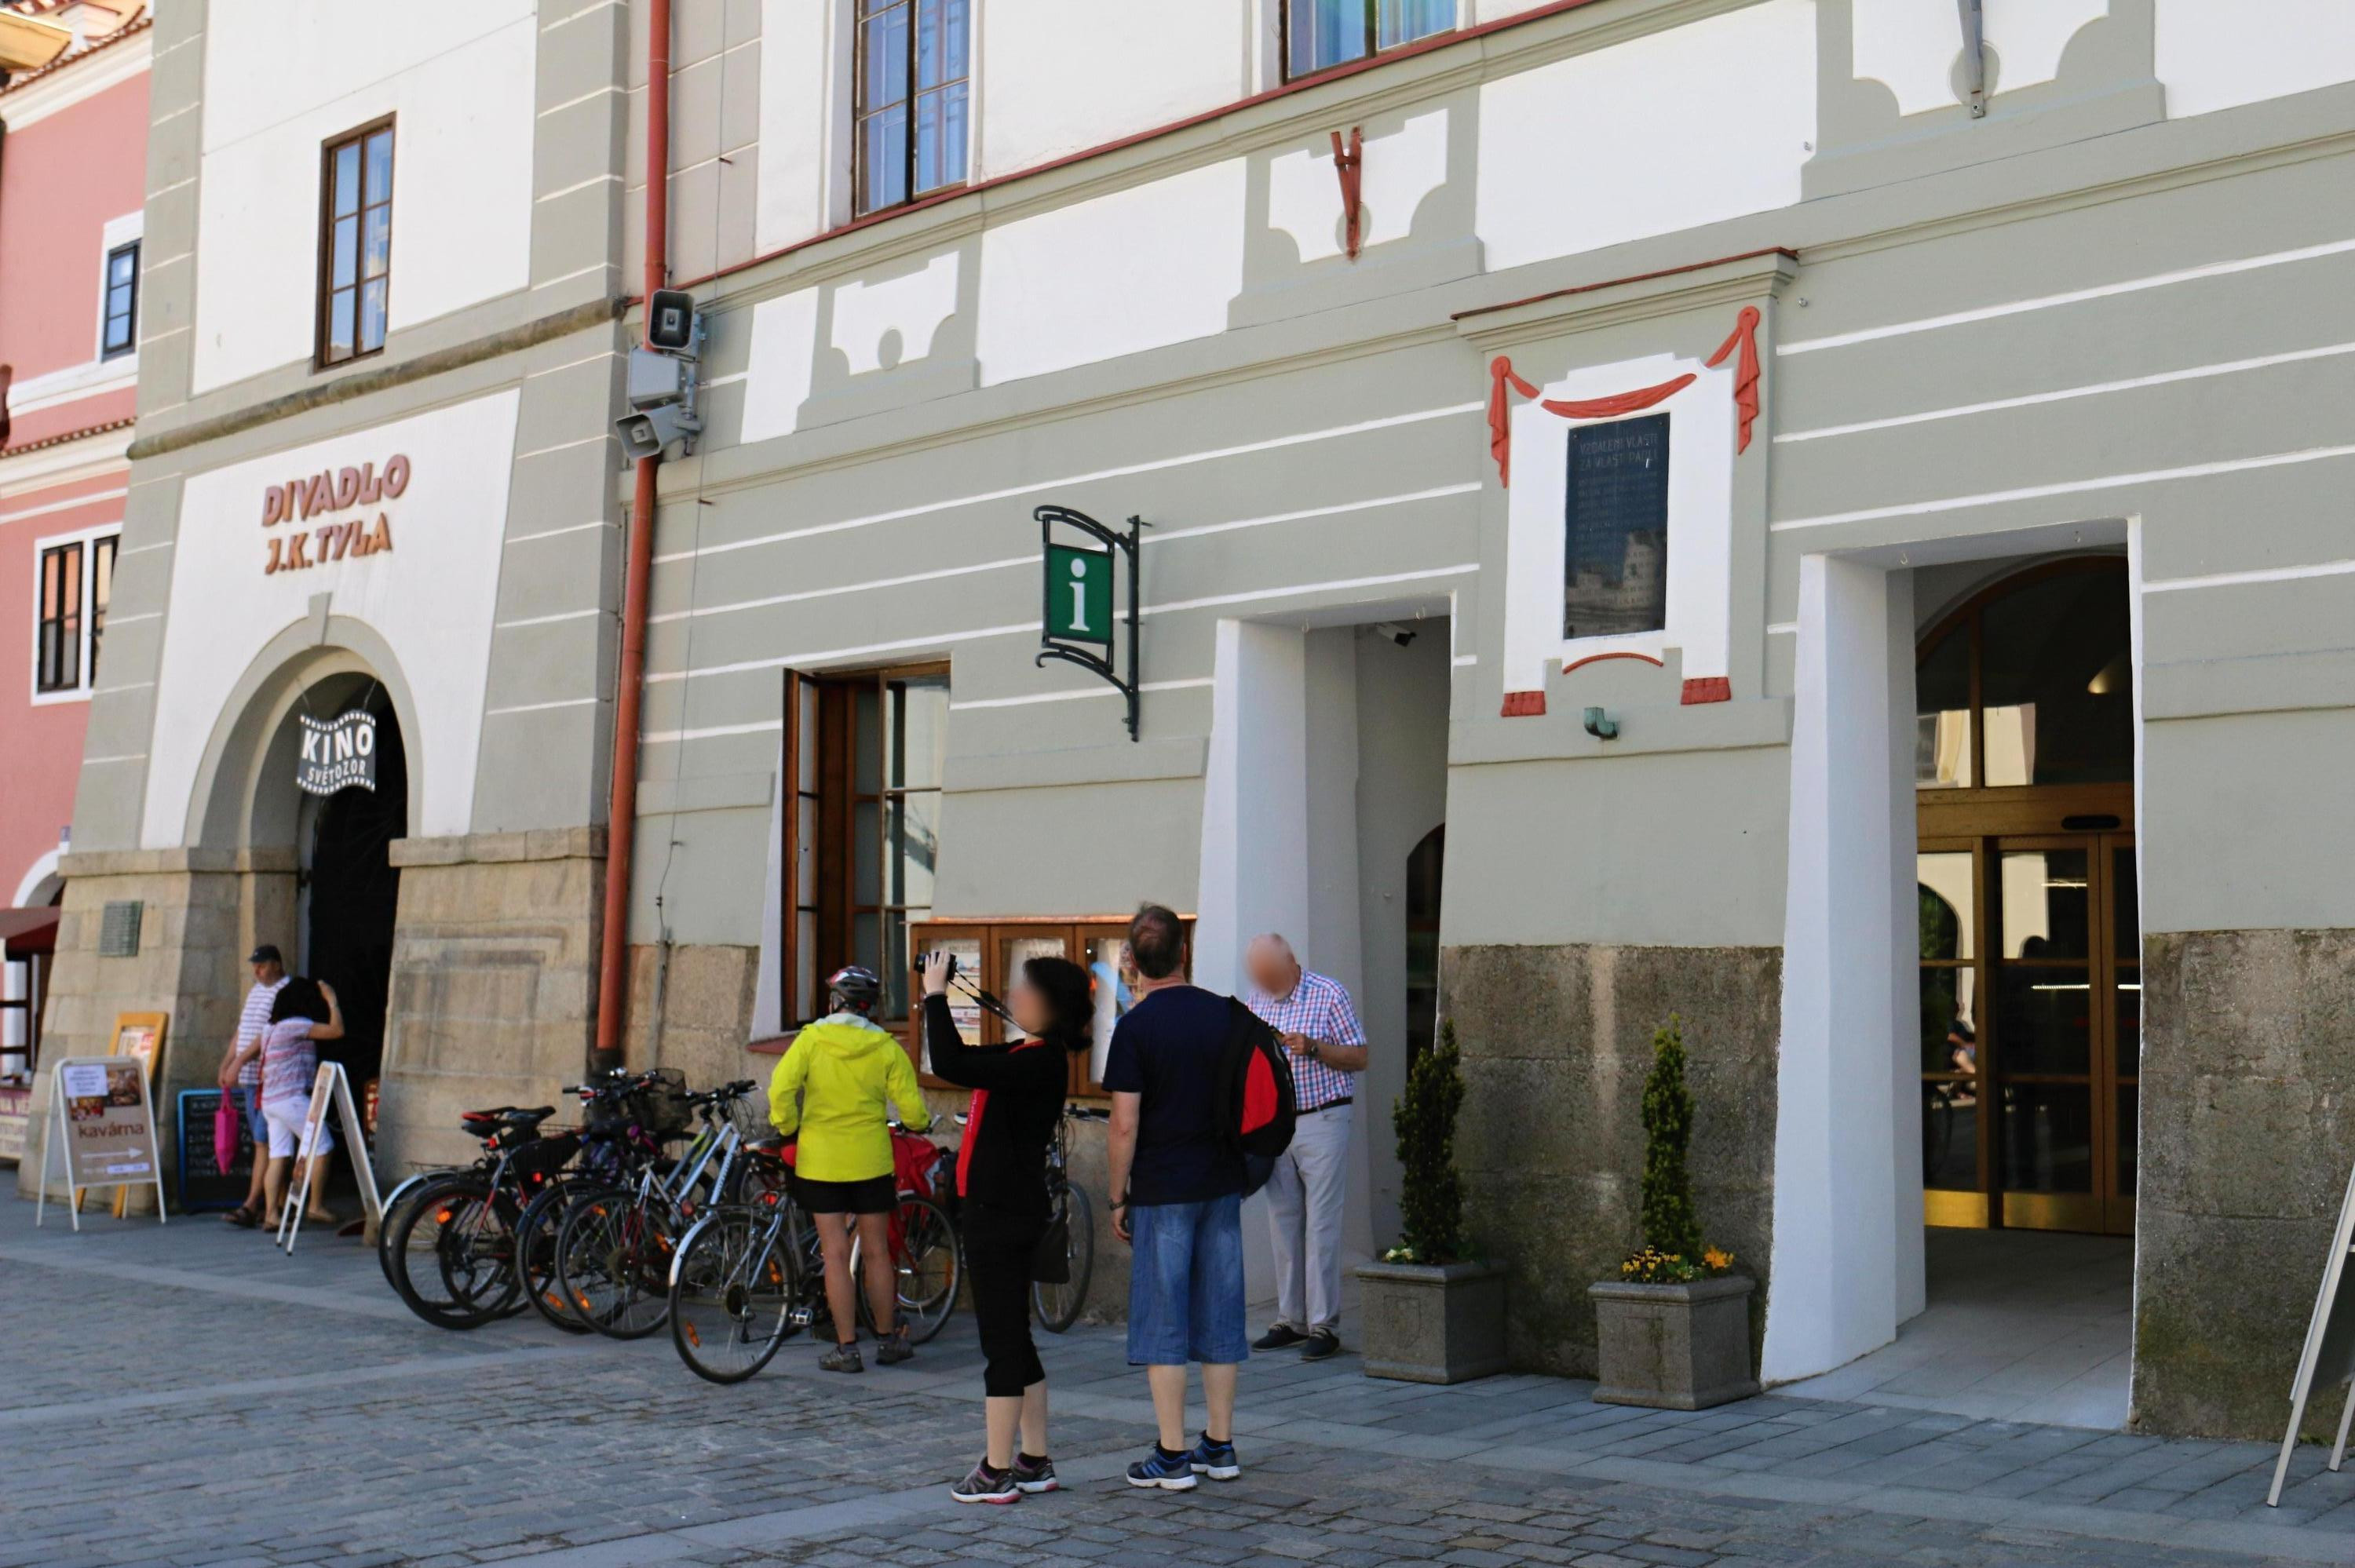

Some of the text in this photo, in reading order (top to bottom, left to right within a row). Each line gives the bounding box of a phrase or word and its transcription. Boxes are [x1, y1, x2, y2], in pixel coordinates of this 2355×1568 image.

[261, 454, 410, 527] DIVADLO
[316, 512, 392, 563] TYLA
[1068, 557, 1090, 632] i
[301, 723, 374, 765] KINO
[307, 758, 367, 786] SVĚTOZOR
[78, 1121, 144, 1139] kavárna
